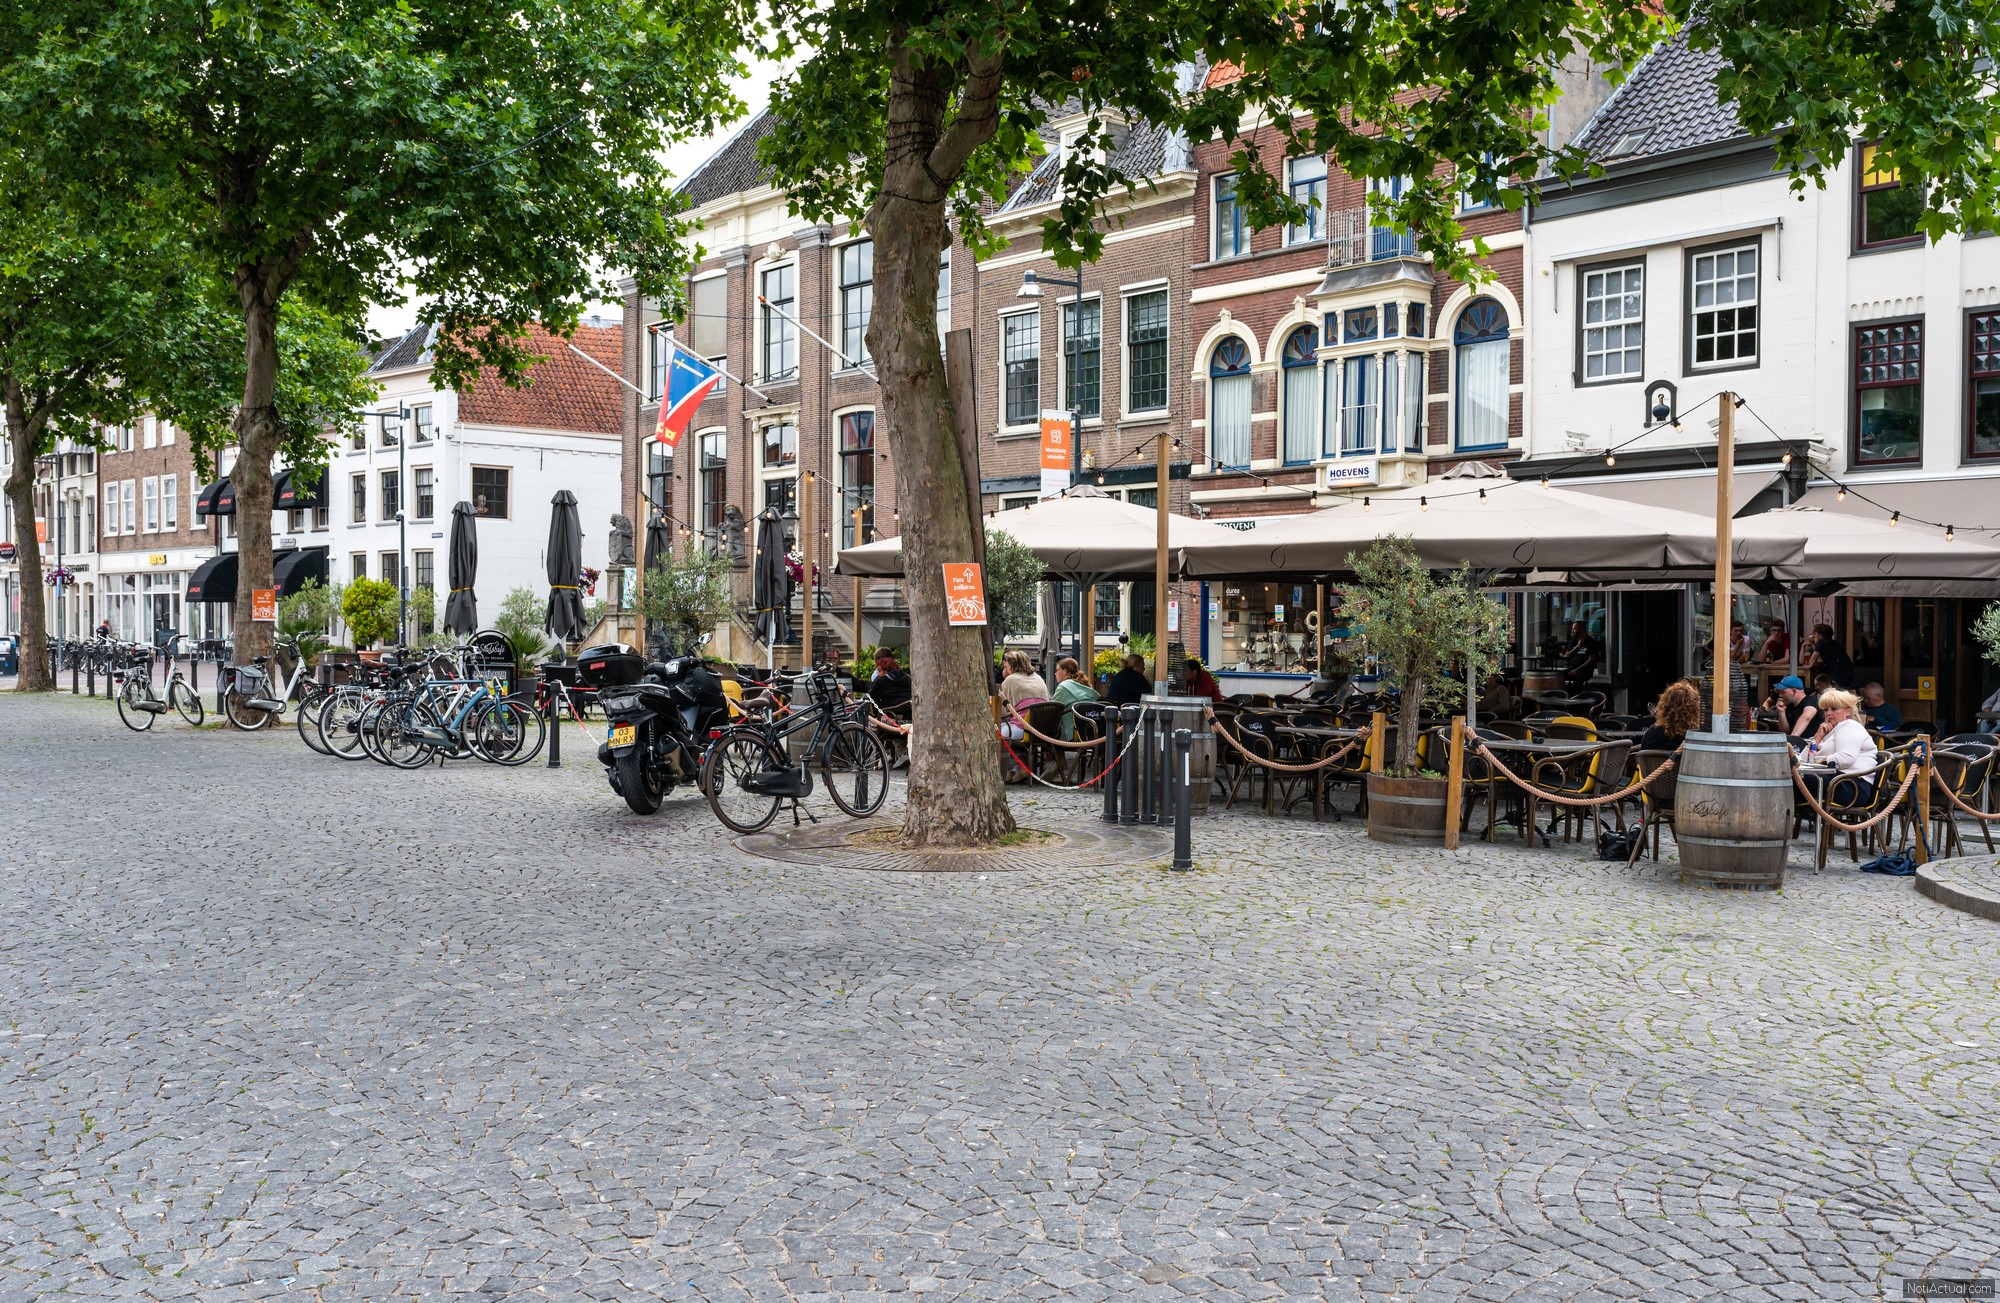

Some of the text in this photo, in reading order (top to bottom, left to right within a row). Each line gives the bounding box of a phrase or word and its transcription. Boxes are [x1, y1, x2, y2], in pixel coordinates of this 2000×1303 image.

[1330, 467, 1370, 478] HOEVENS
[1218, 521, 1255, 530] OEVENS
[618, 728, 629, 736] 03
